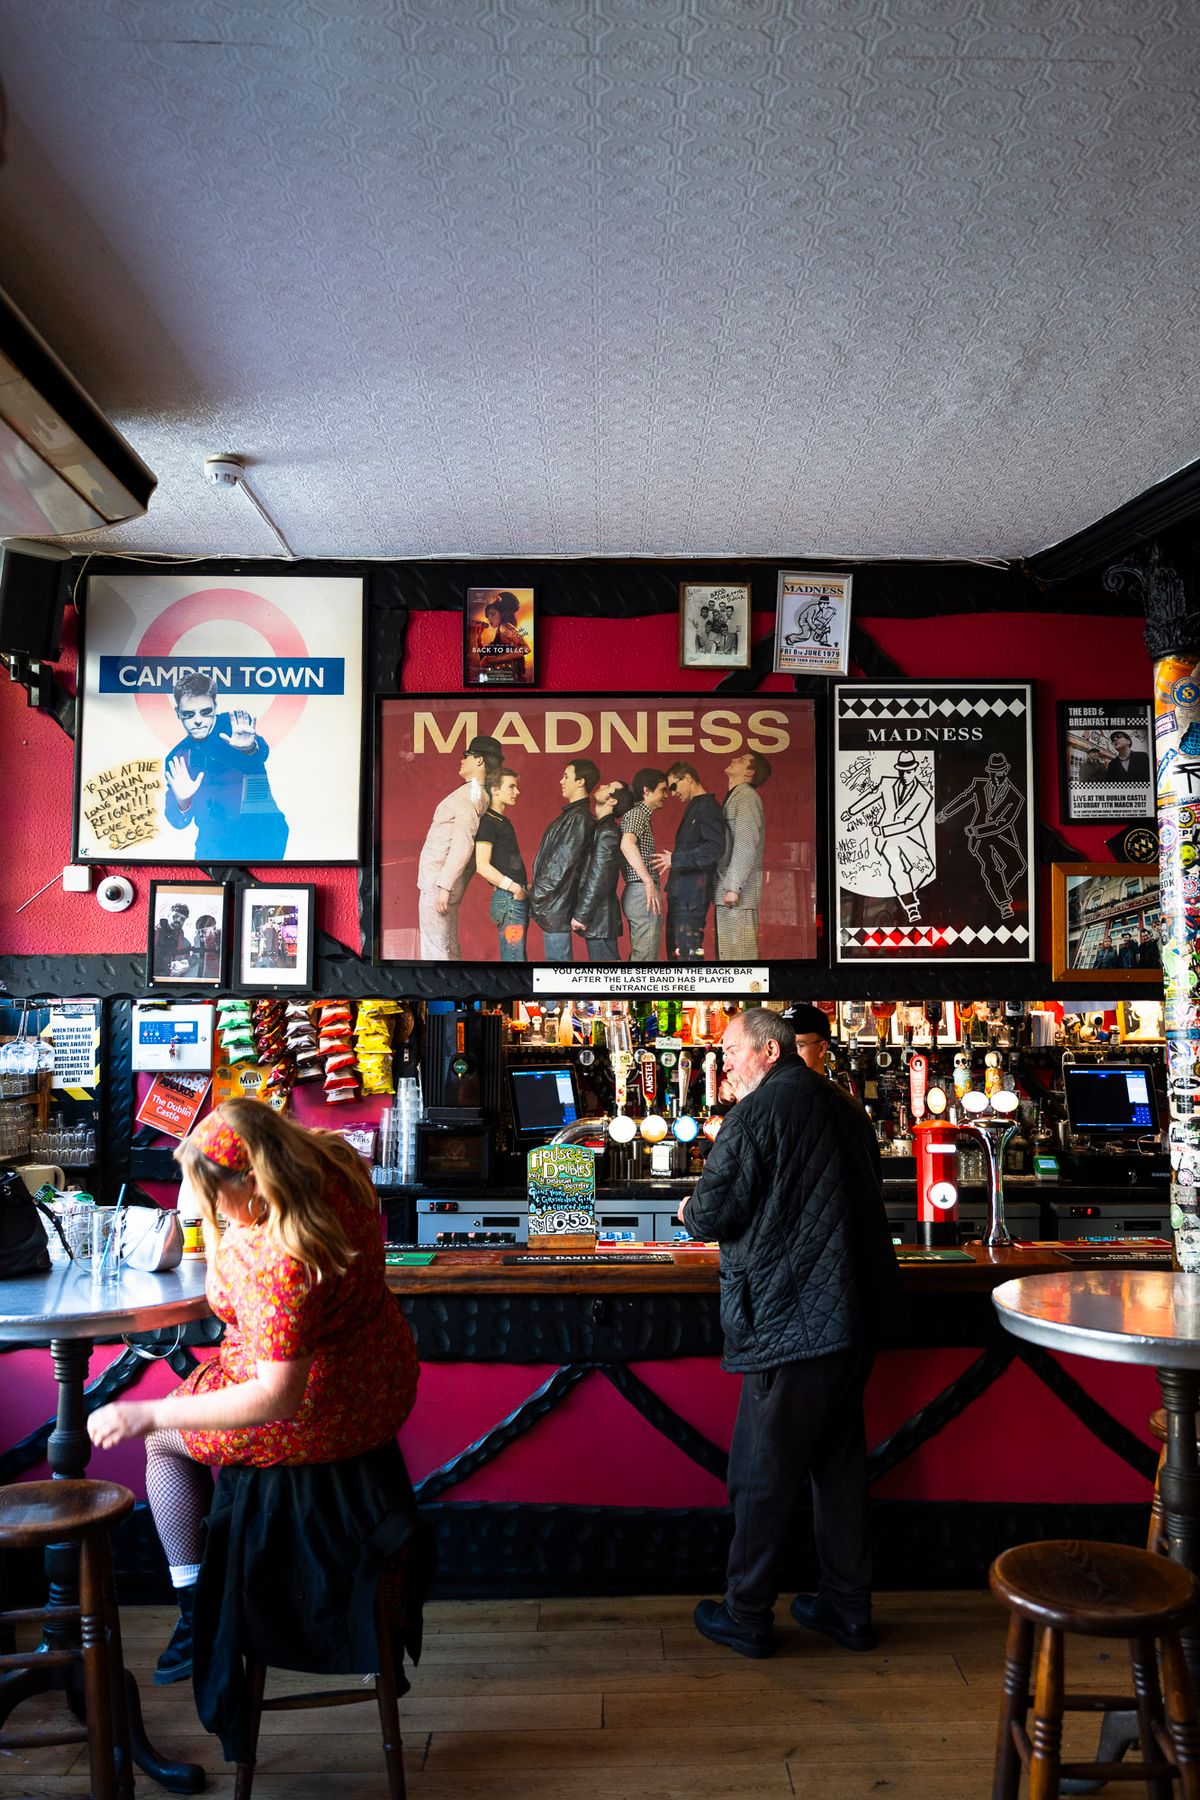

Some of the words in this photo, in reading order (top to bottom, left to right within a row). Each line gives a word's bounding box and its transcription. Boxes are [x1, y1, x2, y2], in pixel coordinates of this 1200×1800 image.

[784, 585, 844, 594] MADNESS
[240, 666, 324, 687] TOWN
[1069, 707, 1082, 716] THE
[1083, 707, 1097, 716] BED
[1098, 707, 1104, 716] &
[1069, 718, 1109, 726] BREAKFAST
[1110, 718, 1126, 726] MEN
[413, 710, 790, 754] MADNESS
[867, 727, 983, 742] MADNESS
[99, 771, 117, 785] ALL
[121, 764, 132, 777] AT
[136, 761, 159, 773] THE
[97, 774, 143, 801] DUBLIN
[84, 801, 111, 820] LONG
[115, 787, 138, 802] MAY
[139, 780, 160, 794] YOU
[95, 822, 126, 839] LOVE
[572, 976, 601, 984] AFTER
[603, 976, 621, 984] THE
[623, 976, 647, 984] LAST
[650, 976, 675, 984] BAND
[677, 976, 697, 984] HAS
[699, 976, 735, 984] PLAYED
[610, 984, 659, 992] ENTRANCE
[645, 1062, 653, 1093] AMSTEL
[159, 1077, 197, 1099] AWARDS
[152, 1094, 166, 1106] The
[167, 1101, 191, 1117] Dublin
[165, 1093, 185, 1104] WINNER
[156, 1106, 180, 1122] Castle
